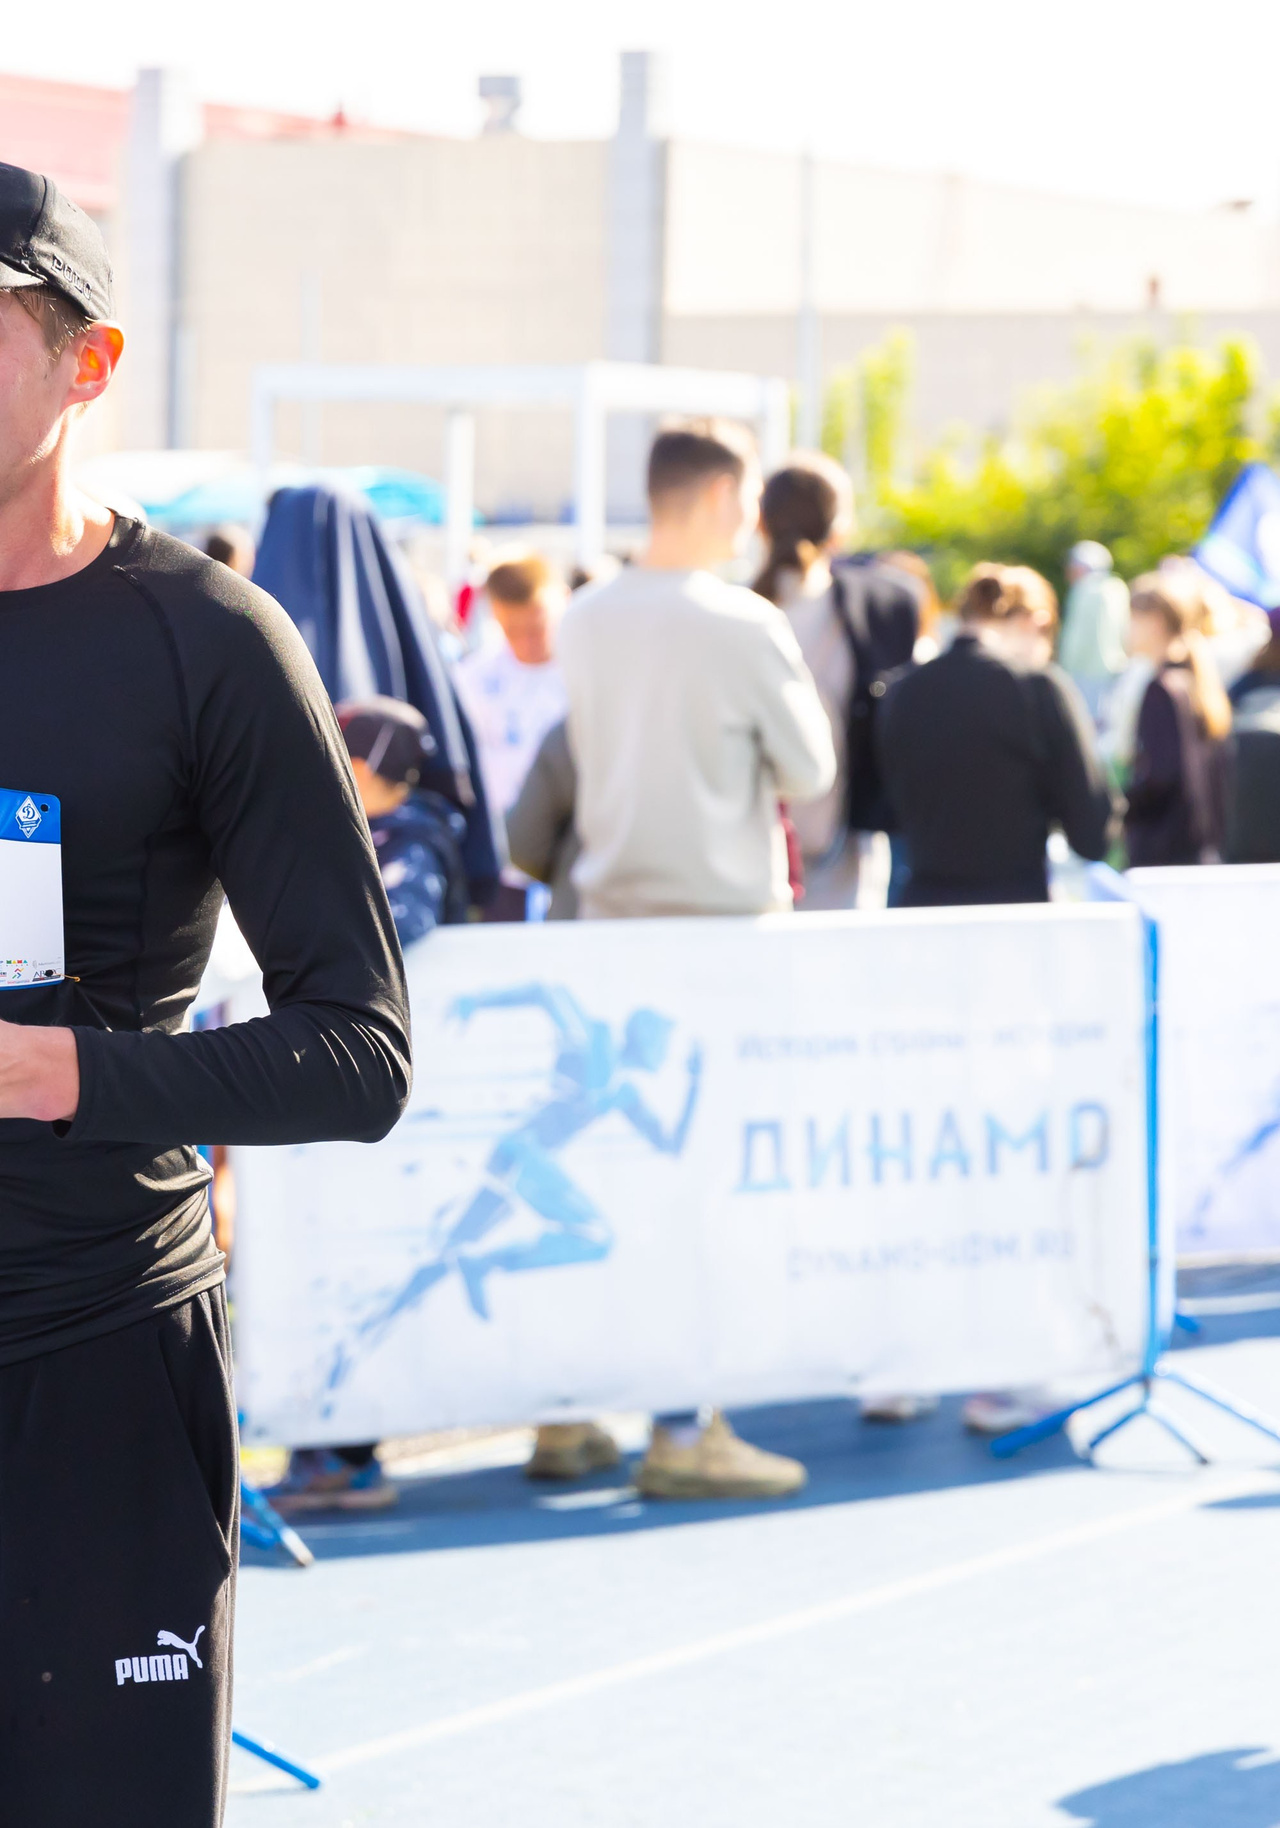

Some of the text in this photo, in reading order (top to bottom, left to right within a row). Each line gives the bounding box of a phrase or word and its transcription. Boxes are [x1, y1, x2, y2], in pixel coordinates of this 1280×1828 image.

[50, 254, 93, 300] POLO
[732, 1100, 1111, 1193] ДИНАМО
[115, 1653, 189, 1686] PUMA
